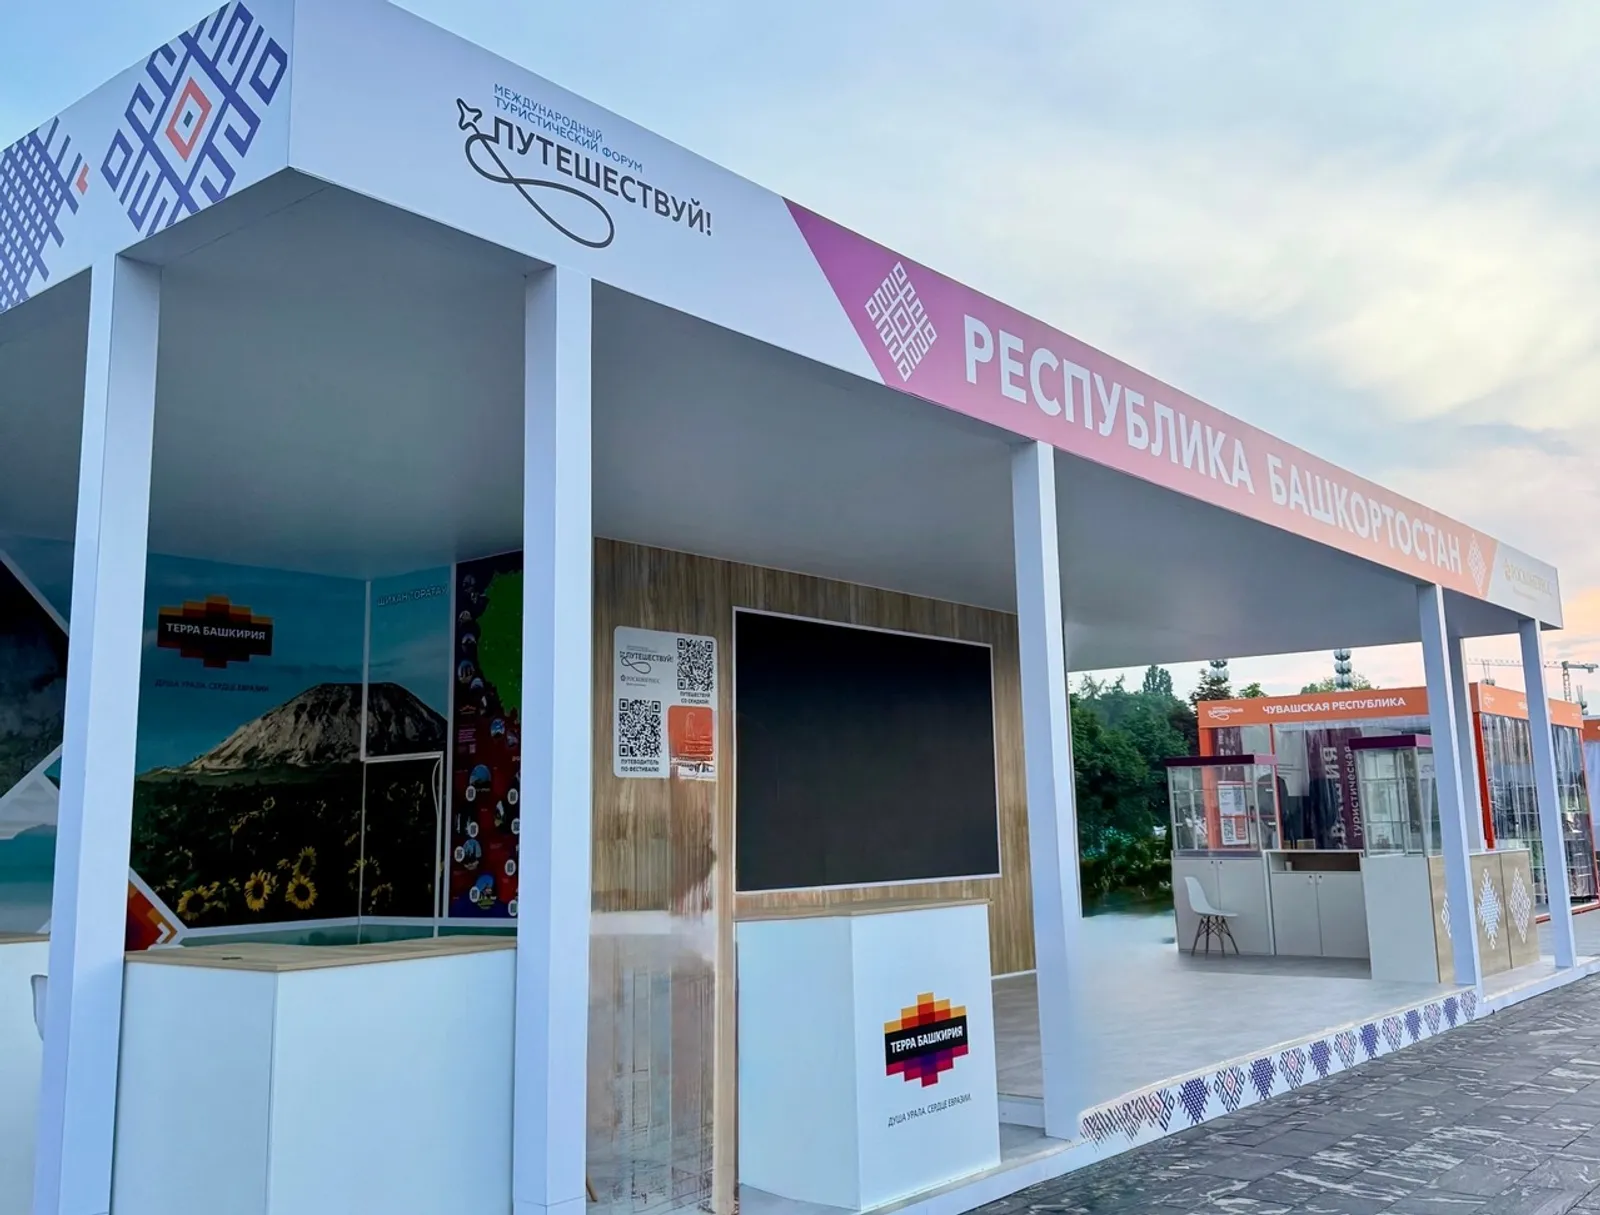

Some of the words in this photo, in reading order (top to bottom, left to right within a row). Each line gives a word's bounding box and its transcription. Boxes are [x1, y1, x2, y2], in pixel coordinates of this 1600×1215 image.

[494, 83, 603, 143] МЕЖДУНАРОДНЫЙ
[494, 95, 599, 154] ТУРИСТИЧЕСКИЙ
[602, 146, 643, 174] ФОРУМ
[494, 116, 712, 237] ПУТЕШЕСТВУЙ!
[964, 314, 1256, 496] РЕСПУБЛИКА
[1266, 453, 1463, 575] БАШКОРТОСТАН
[167, 622, 201, 635] ТЕРРА
[203, 626, 266, 641] БАШКИРИЯ
[1262, 703, 1329, 715] ЧУВАШСКАЯ
[1332, 697, 1406, 711] РЕСПУБЛИКА
[890, 1038, 917, 1054] ТЕРРА
[917, 1025, 964, 1047] БАШКИРИЯ
[888, 1113, 907, 1128] ДУША
[927, 1100, 948, 1114] СЕРДЦЕ
